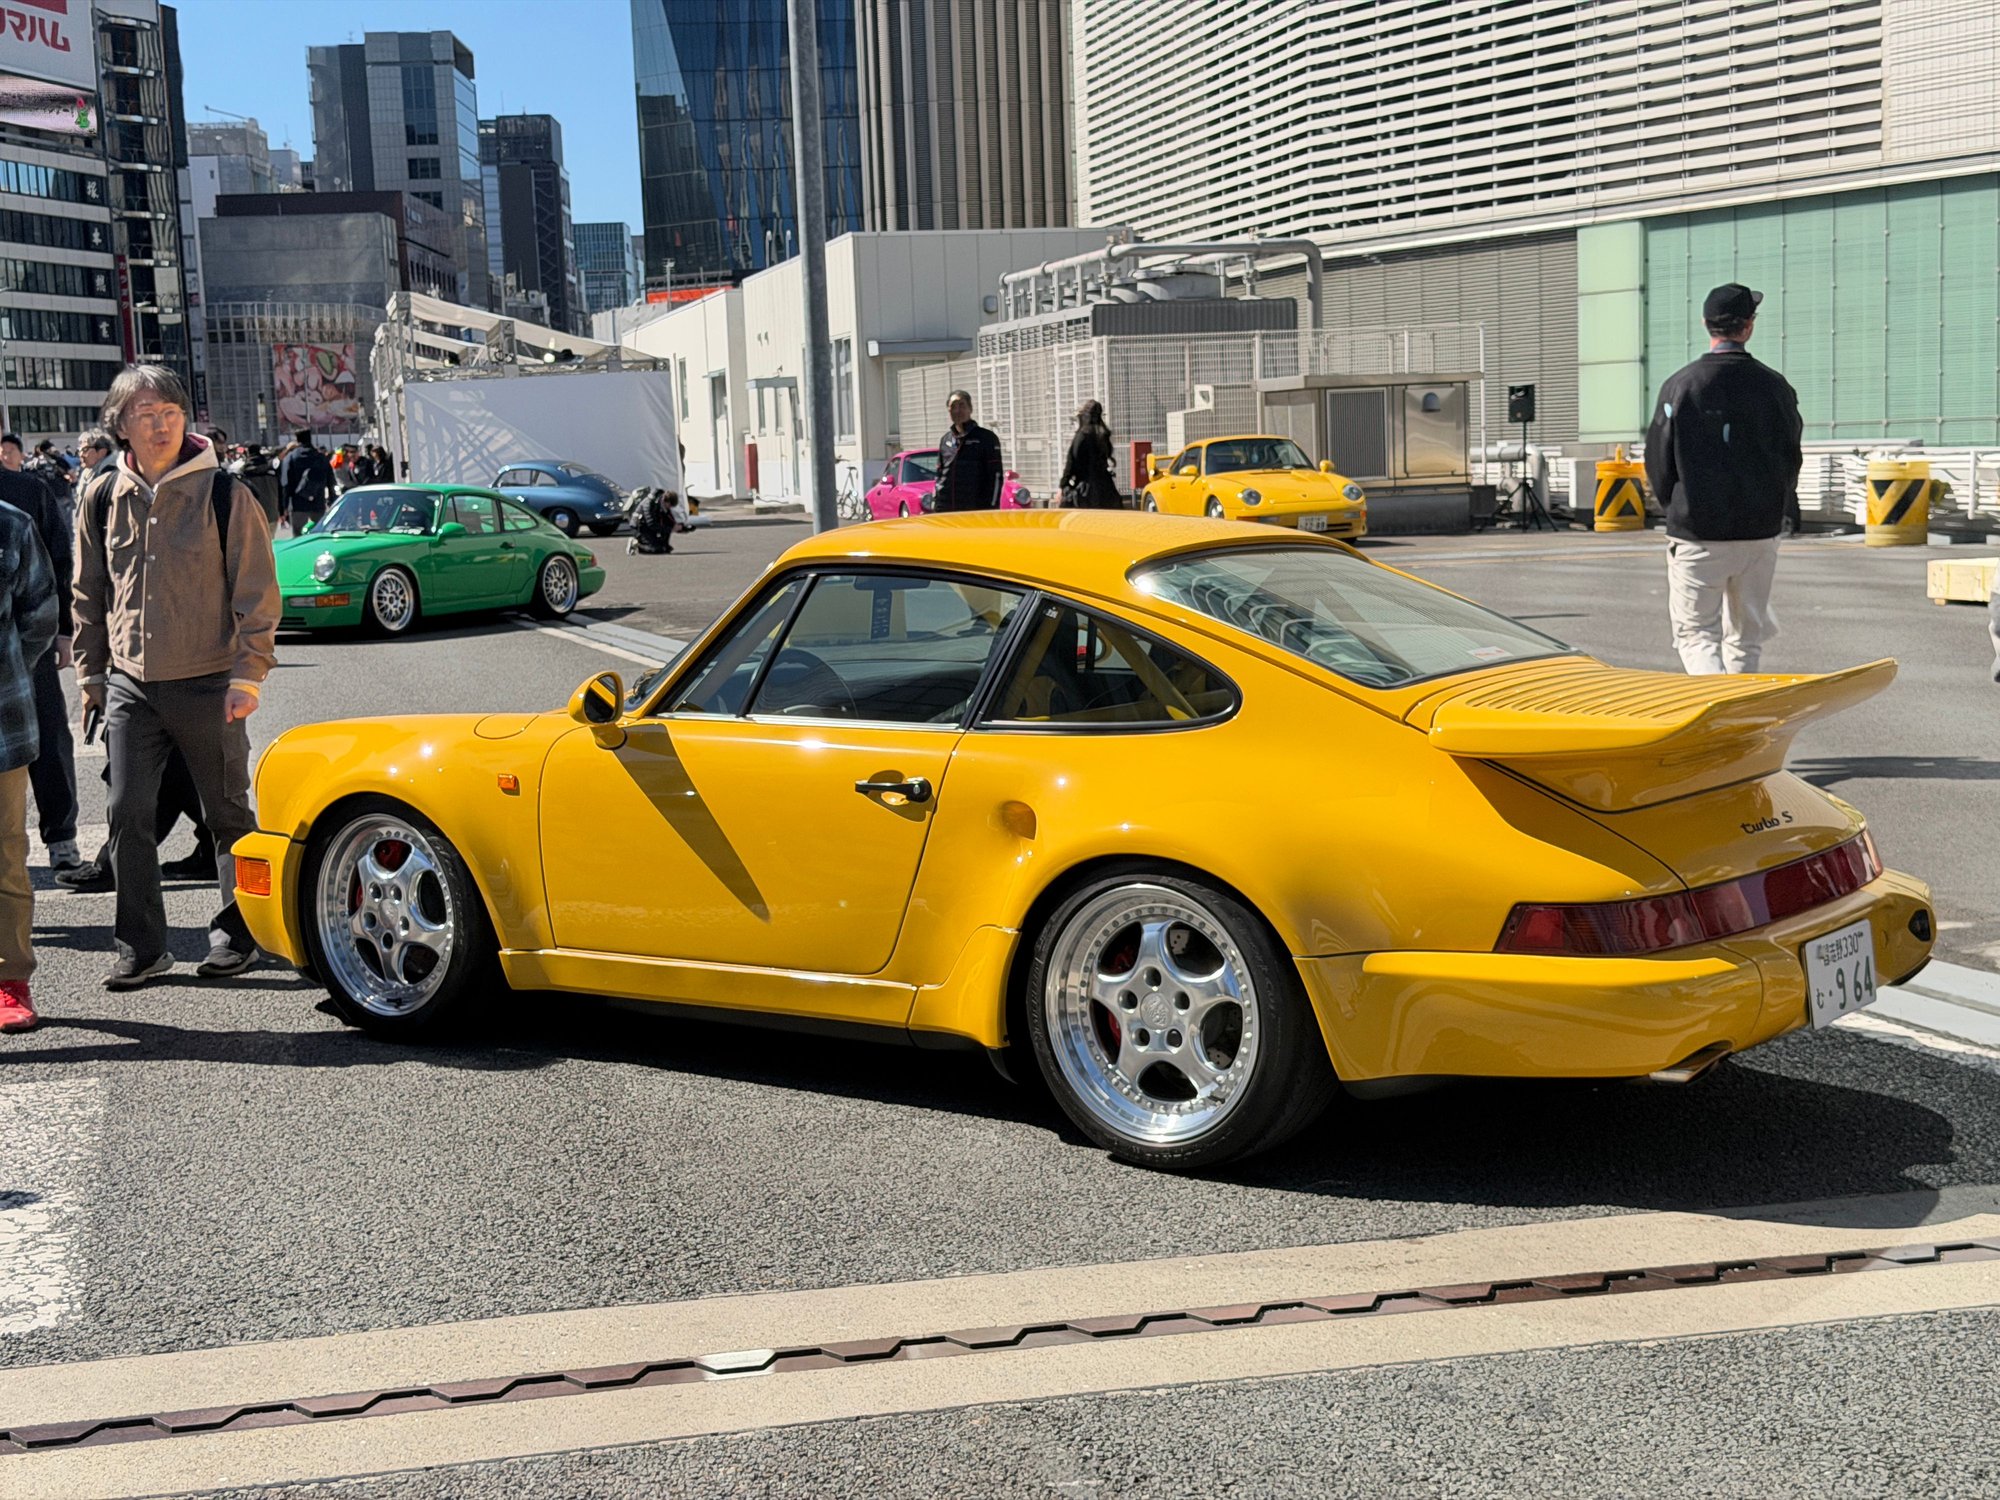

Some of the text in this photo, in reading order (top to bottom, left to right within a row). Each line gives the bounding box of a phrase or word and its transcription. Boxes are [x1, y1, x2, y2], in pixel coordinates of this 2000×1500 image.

[1740, 811, 1793, 835] turbo S
[1842, 932, 1859, 957] 330
